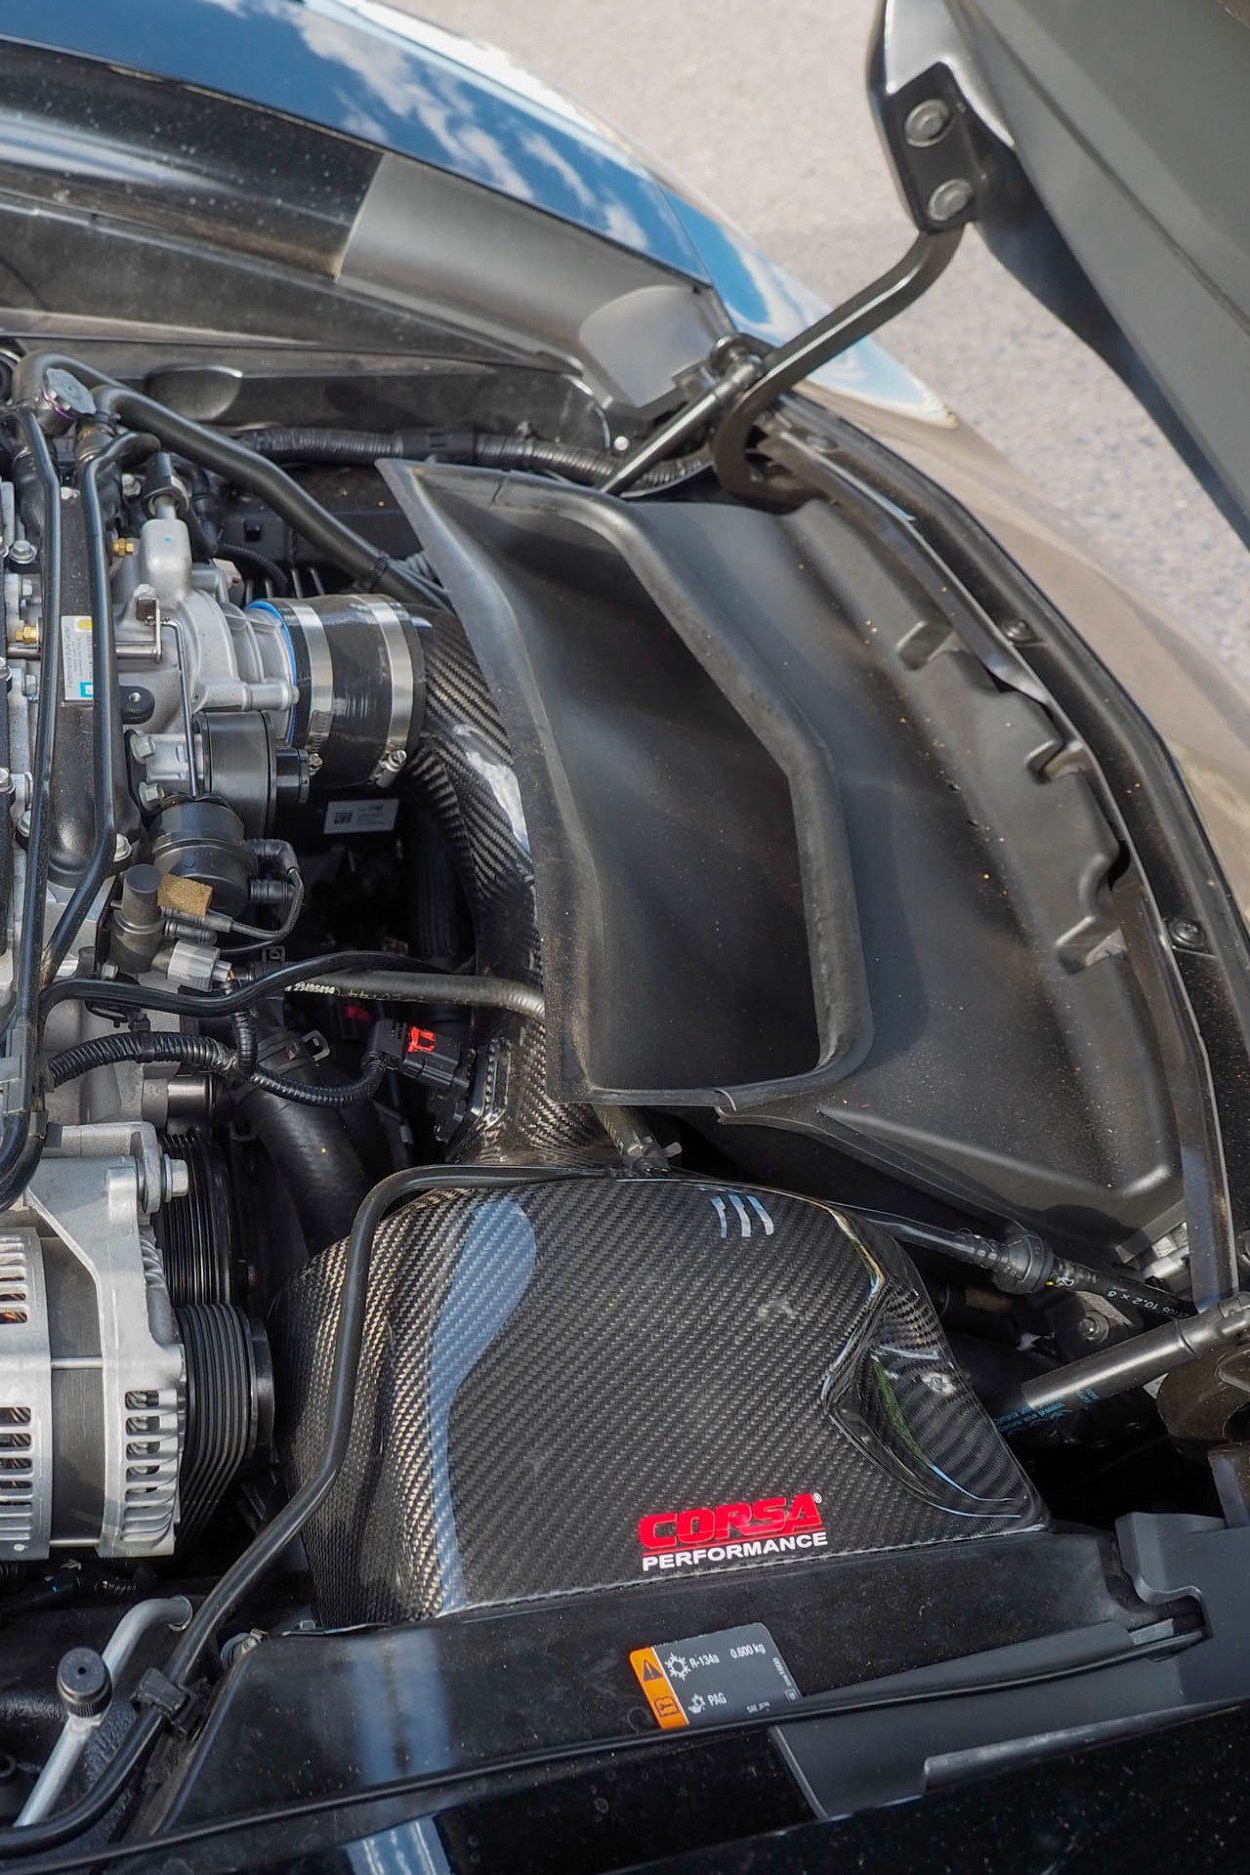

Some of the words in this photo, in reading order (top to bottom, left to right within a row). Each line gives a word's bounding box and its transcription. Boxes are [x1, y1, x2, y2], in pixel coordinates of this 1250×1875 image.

[637, 1493, 823, 1549] CORSA
[642, 1532, 829, 1571] PERFORMANCE
[707, 1692, 728, 1707] PAG
